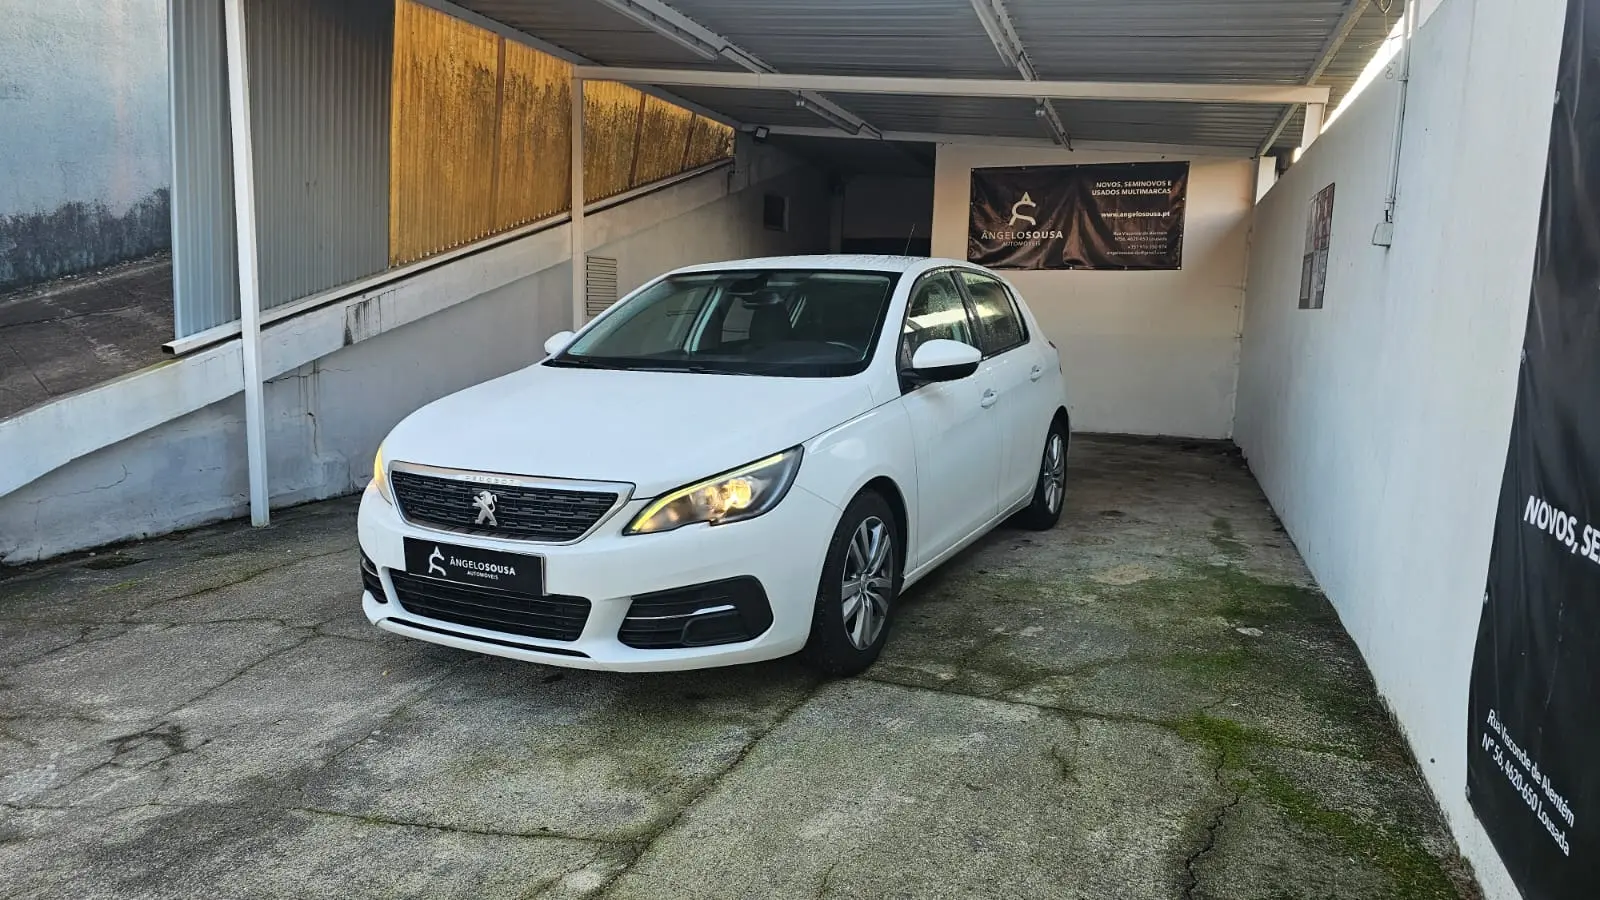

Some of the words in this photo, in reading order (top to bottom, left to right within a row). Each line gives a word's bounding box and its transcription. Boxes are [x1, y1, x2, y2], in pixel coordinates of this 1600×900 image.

[1523, 495, 1579, 554] NOVOS,
[1580, 524, 1600, 565] SE
[1486, 708, 1501, 735] Rua
[1500, 722, 1532, 771] Visconde
[1531, 762, 1542, 785] de
[1541, 775, 1575, 828] Alentém
[1492, 744, 1504, 771] 56,
[1505, 759, 1538, 812] 4620-650
[1537, 801, 1569, 857] Lousada
